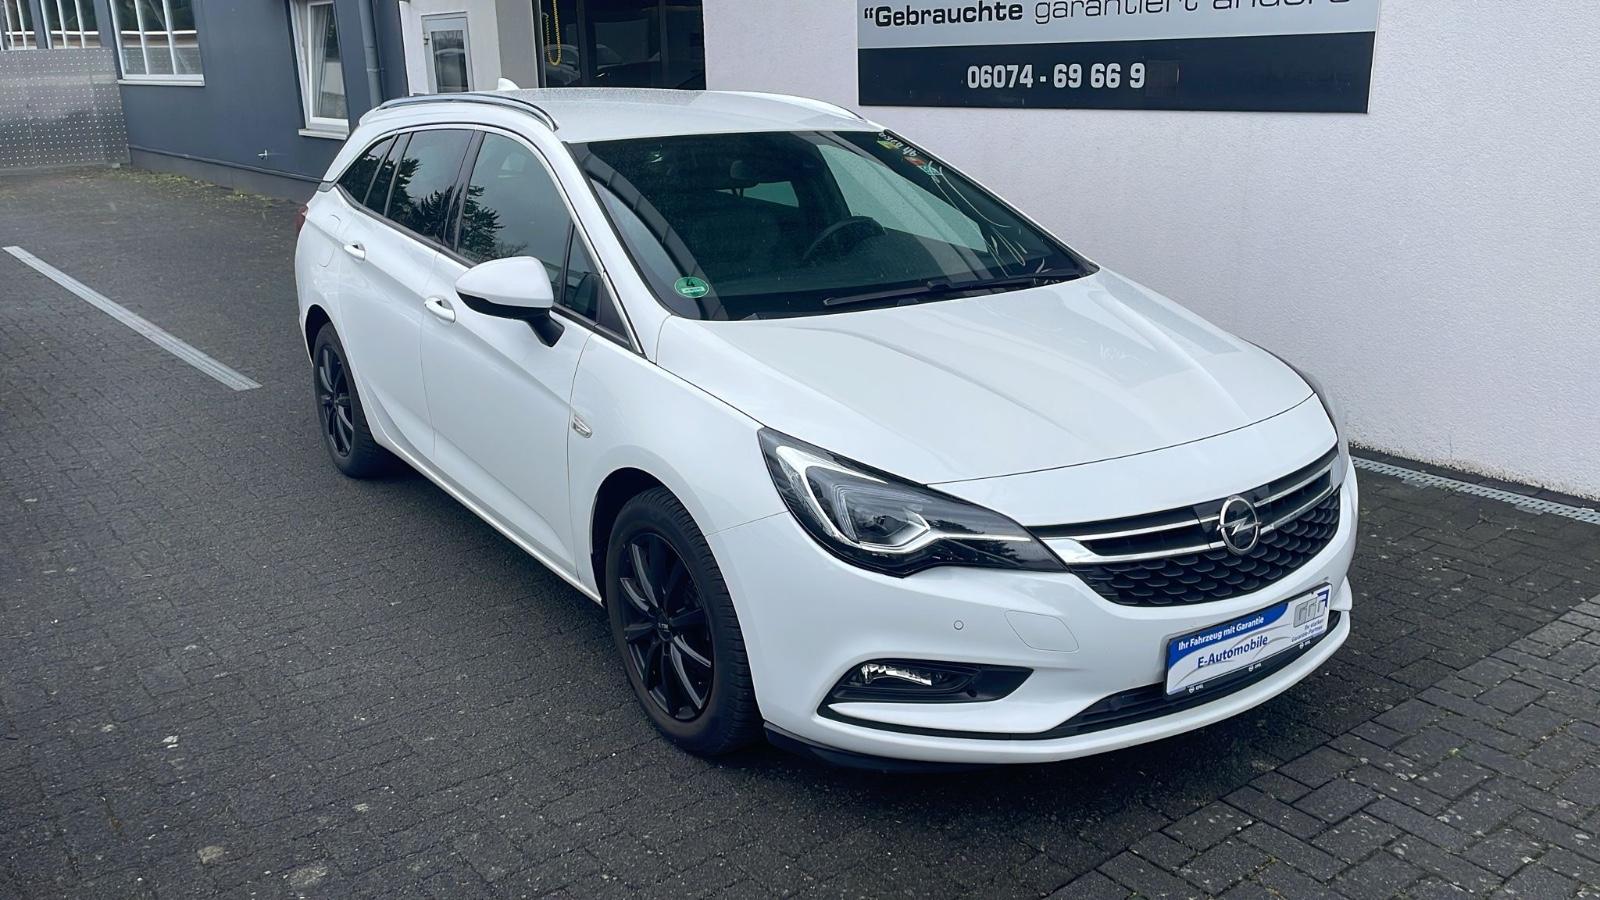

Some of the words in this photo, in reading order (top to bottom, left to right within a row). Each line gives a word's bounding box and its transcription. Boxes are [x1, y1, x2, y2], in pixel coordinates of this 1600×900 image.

[967, 64, 1033, 88] 06074
[1039, 75, 1047, 83] -
[1053, 63, 1082, 88] 69
[1090, 63, 1121, 88] 66
[1129, 62, 1146, 88] 9
[1178, 640, 1189, 651] Ihr
[1190, 631, 1223, 647] Fahrzeug
[1223, 625, 1235, 637] mit
[1236, 616, 1264, 632] Garantie
[1197, 635, 1268, 669] E-Automobile
